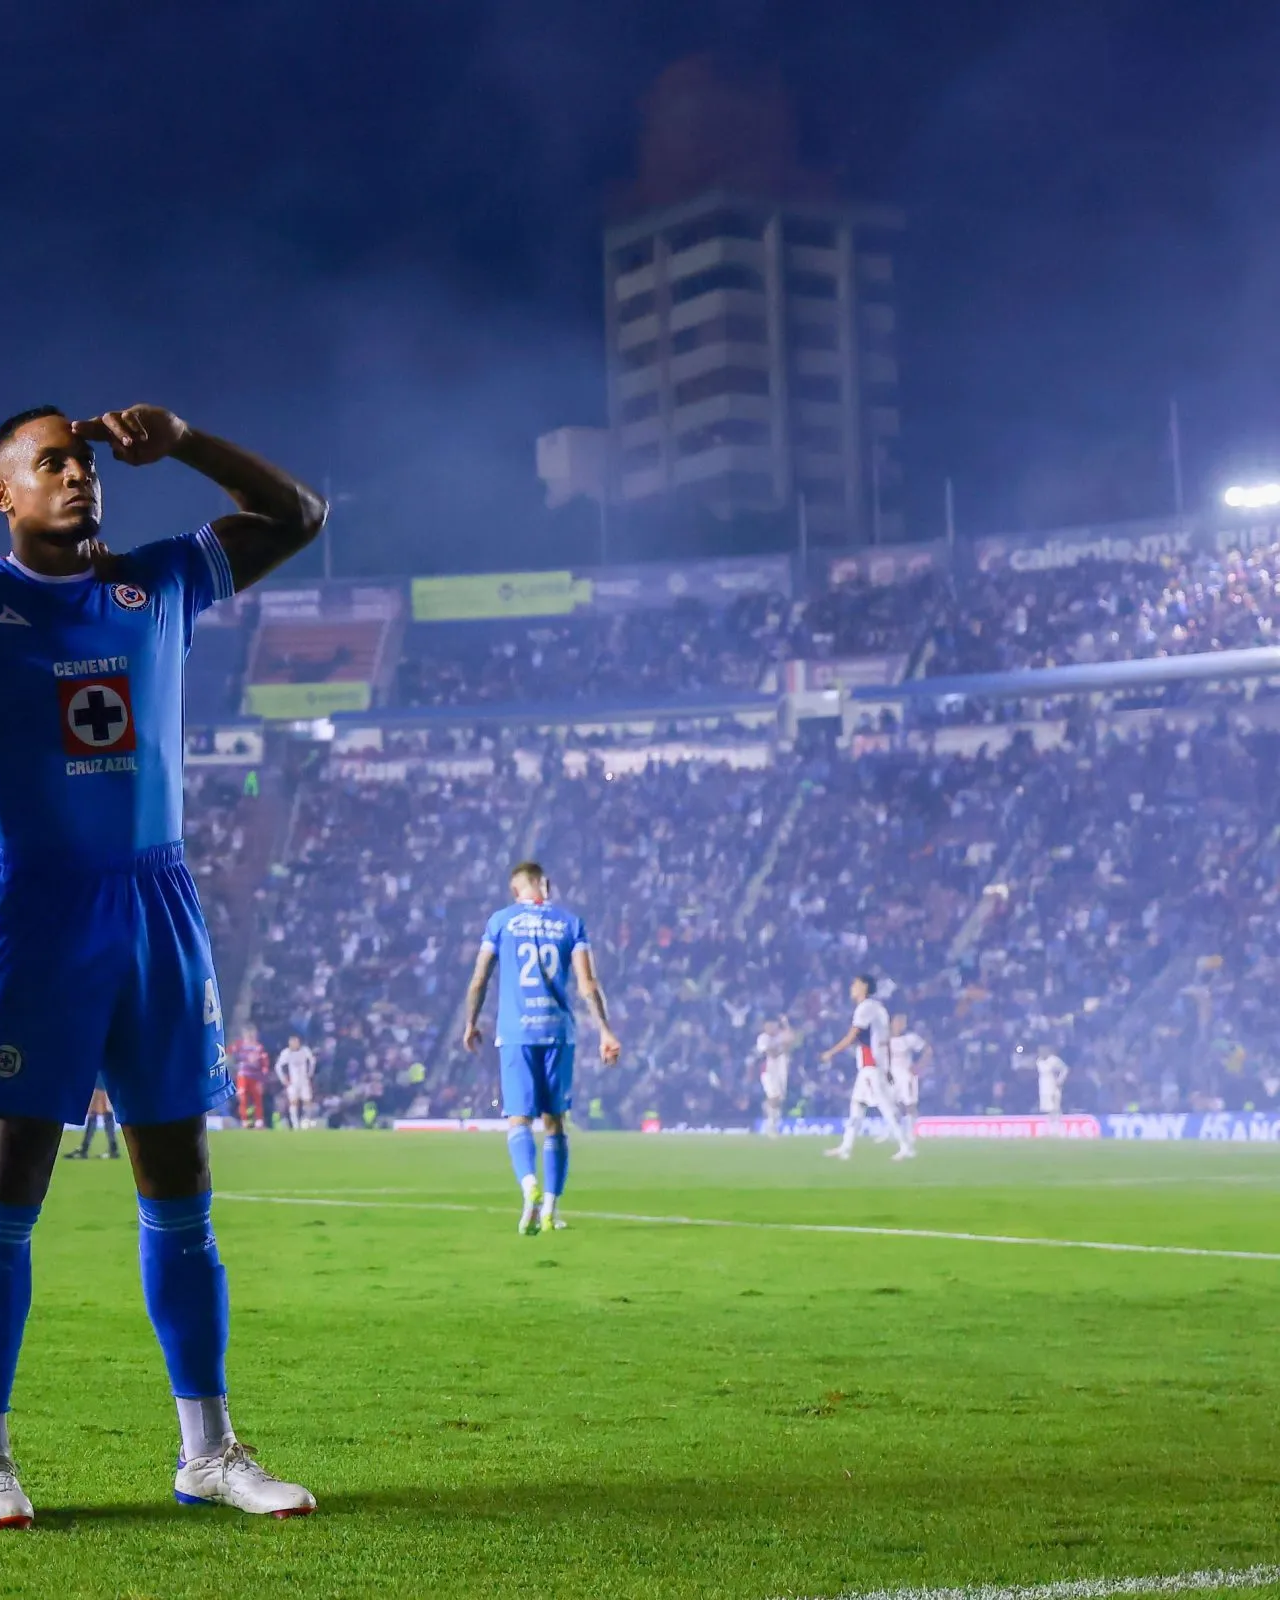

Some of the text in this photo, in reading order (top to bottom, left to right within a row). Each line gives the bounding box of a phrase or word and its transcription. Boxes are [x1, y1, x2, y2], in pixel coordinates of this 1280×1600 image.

[52, 655, 129, 677] CEMENTO
[65, 755, 140, 777] CRUZ AZUL
[1107, 1113, 1189, 1140] TONY
